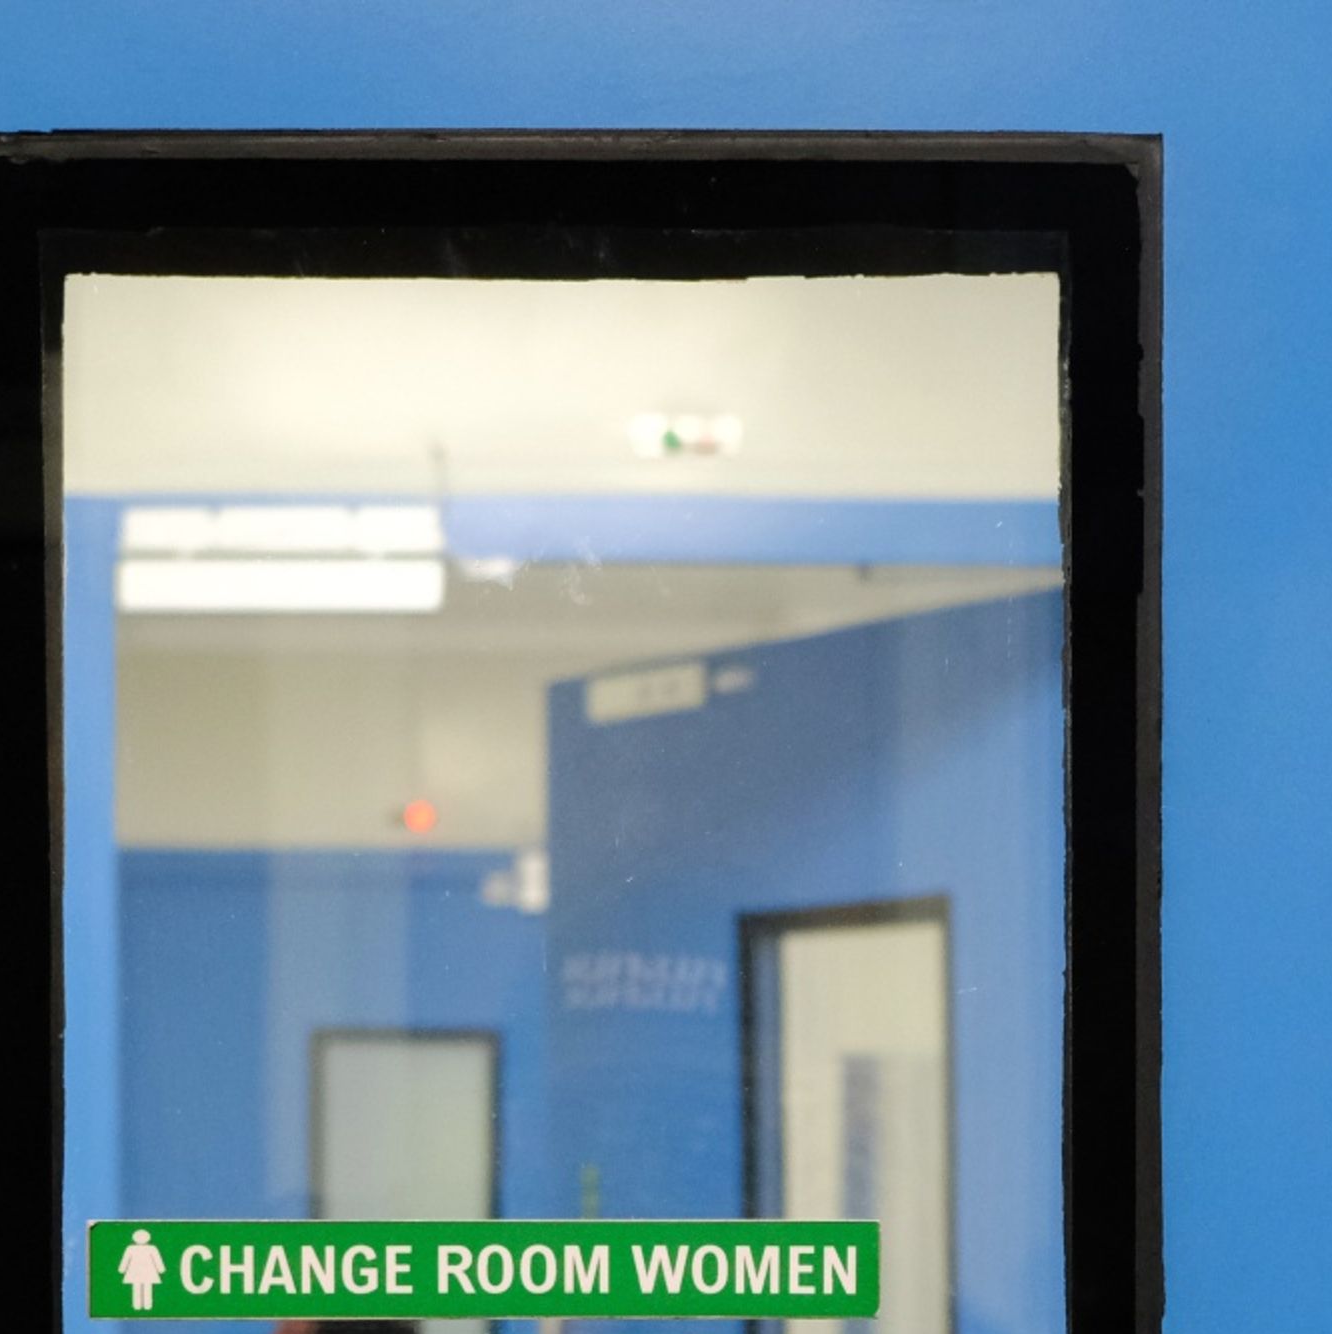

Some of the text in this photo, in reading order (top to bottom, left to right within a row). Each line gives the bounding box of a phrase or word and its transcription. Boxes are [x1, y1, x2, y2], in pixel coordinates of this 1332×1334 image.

[179, 1243, 857, 1295] CHANGE ROOM WOMEN
